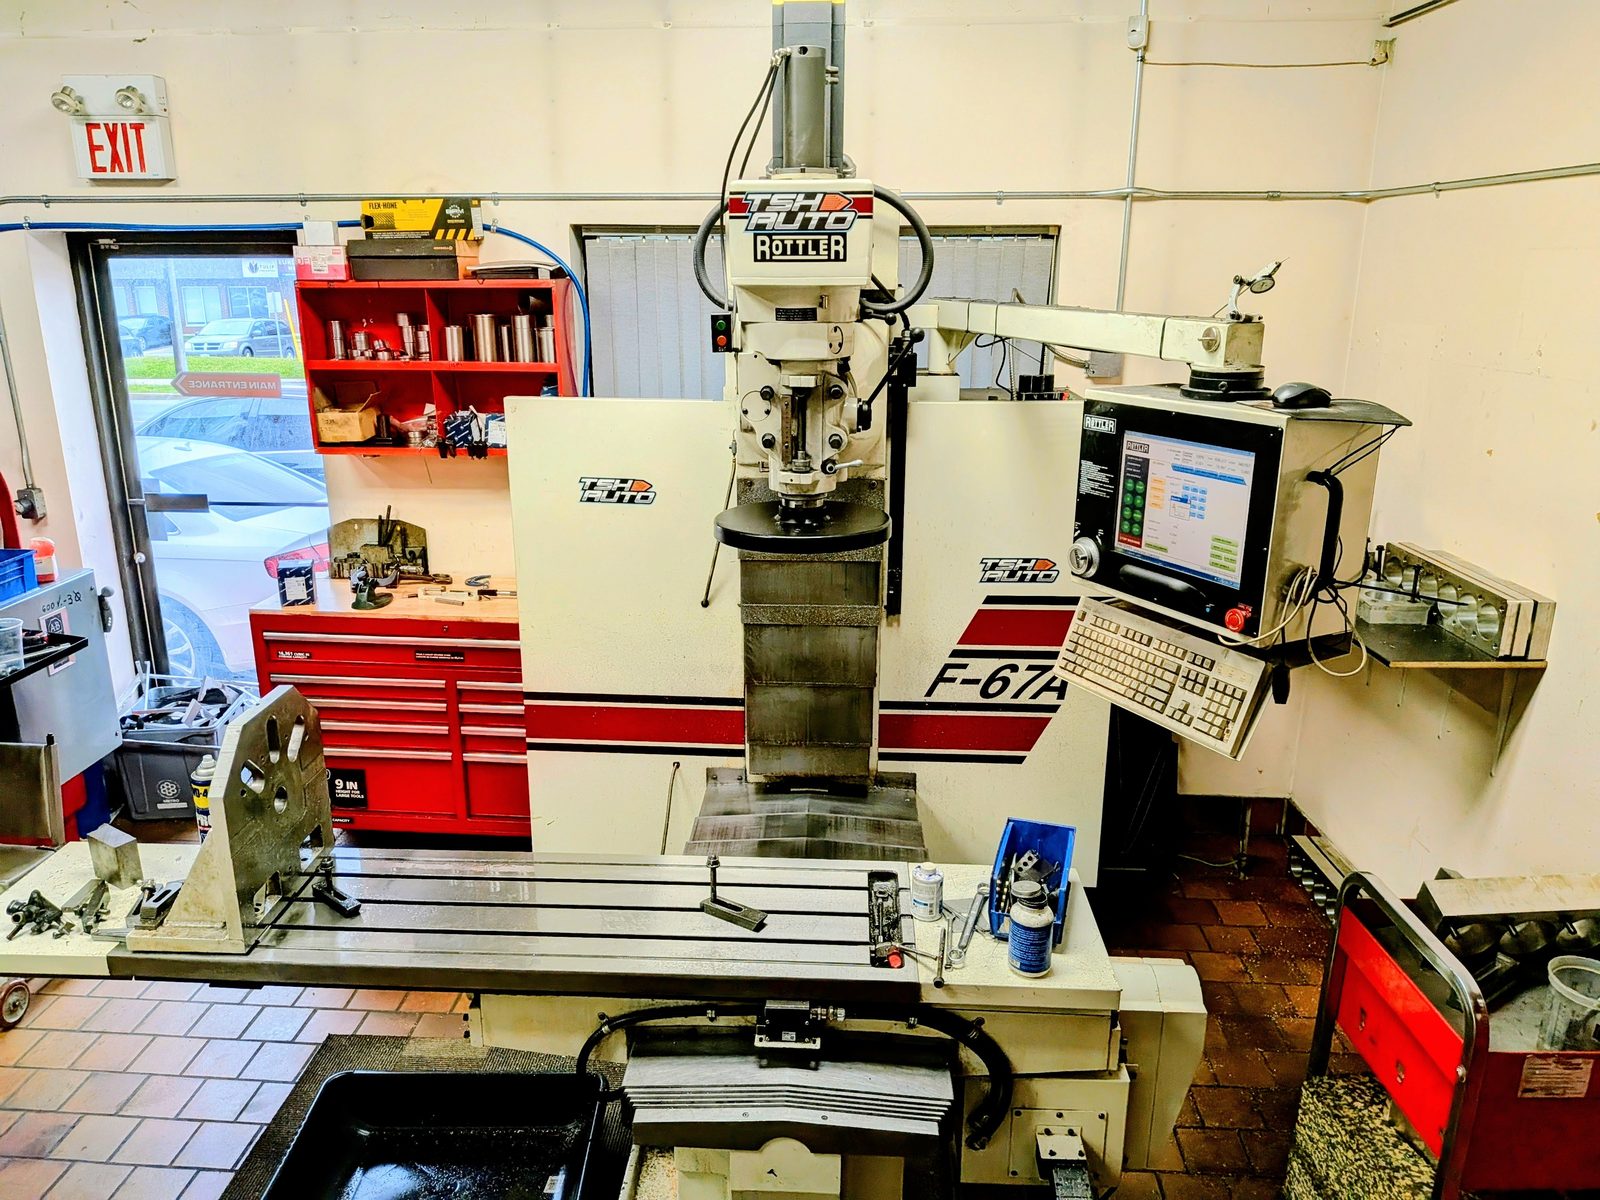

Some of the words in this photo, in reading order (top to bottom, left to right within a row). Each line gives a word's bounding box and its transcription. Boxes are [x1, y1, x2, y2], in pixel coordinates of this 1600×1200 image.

[85, 123, 146, 173] EXIT
[746, 193, 824, 212] TSH
[747, 211, 855, 231] AUTO
[756, 235, 844, 260] ROTTLER
[580, 478, 634, 491] TSH
[581, 490, 656, 503] AUTO
[981, 559, 1036, 571] TSH
[981, 570, 1059, 582] AUTO
[923, 663, 1069, 701] F-67A
[334, 778, 344, 790] 9
[345, 781, 358, 790] IN
